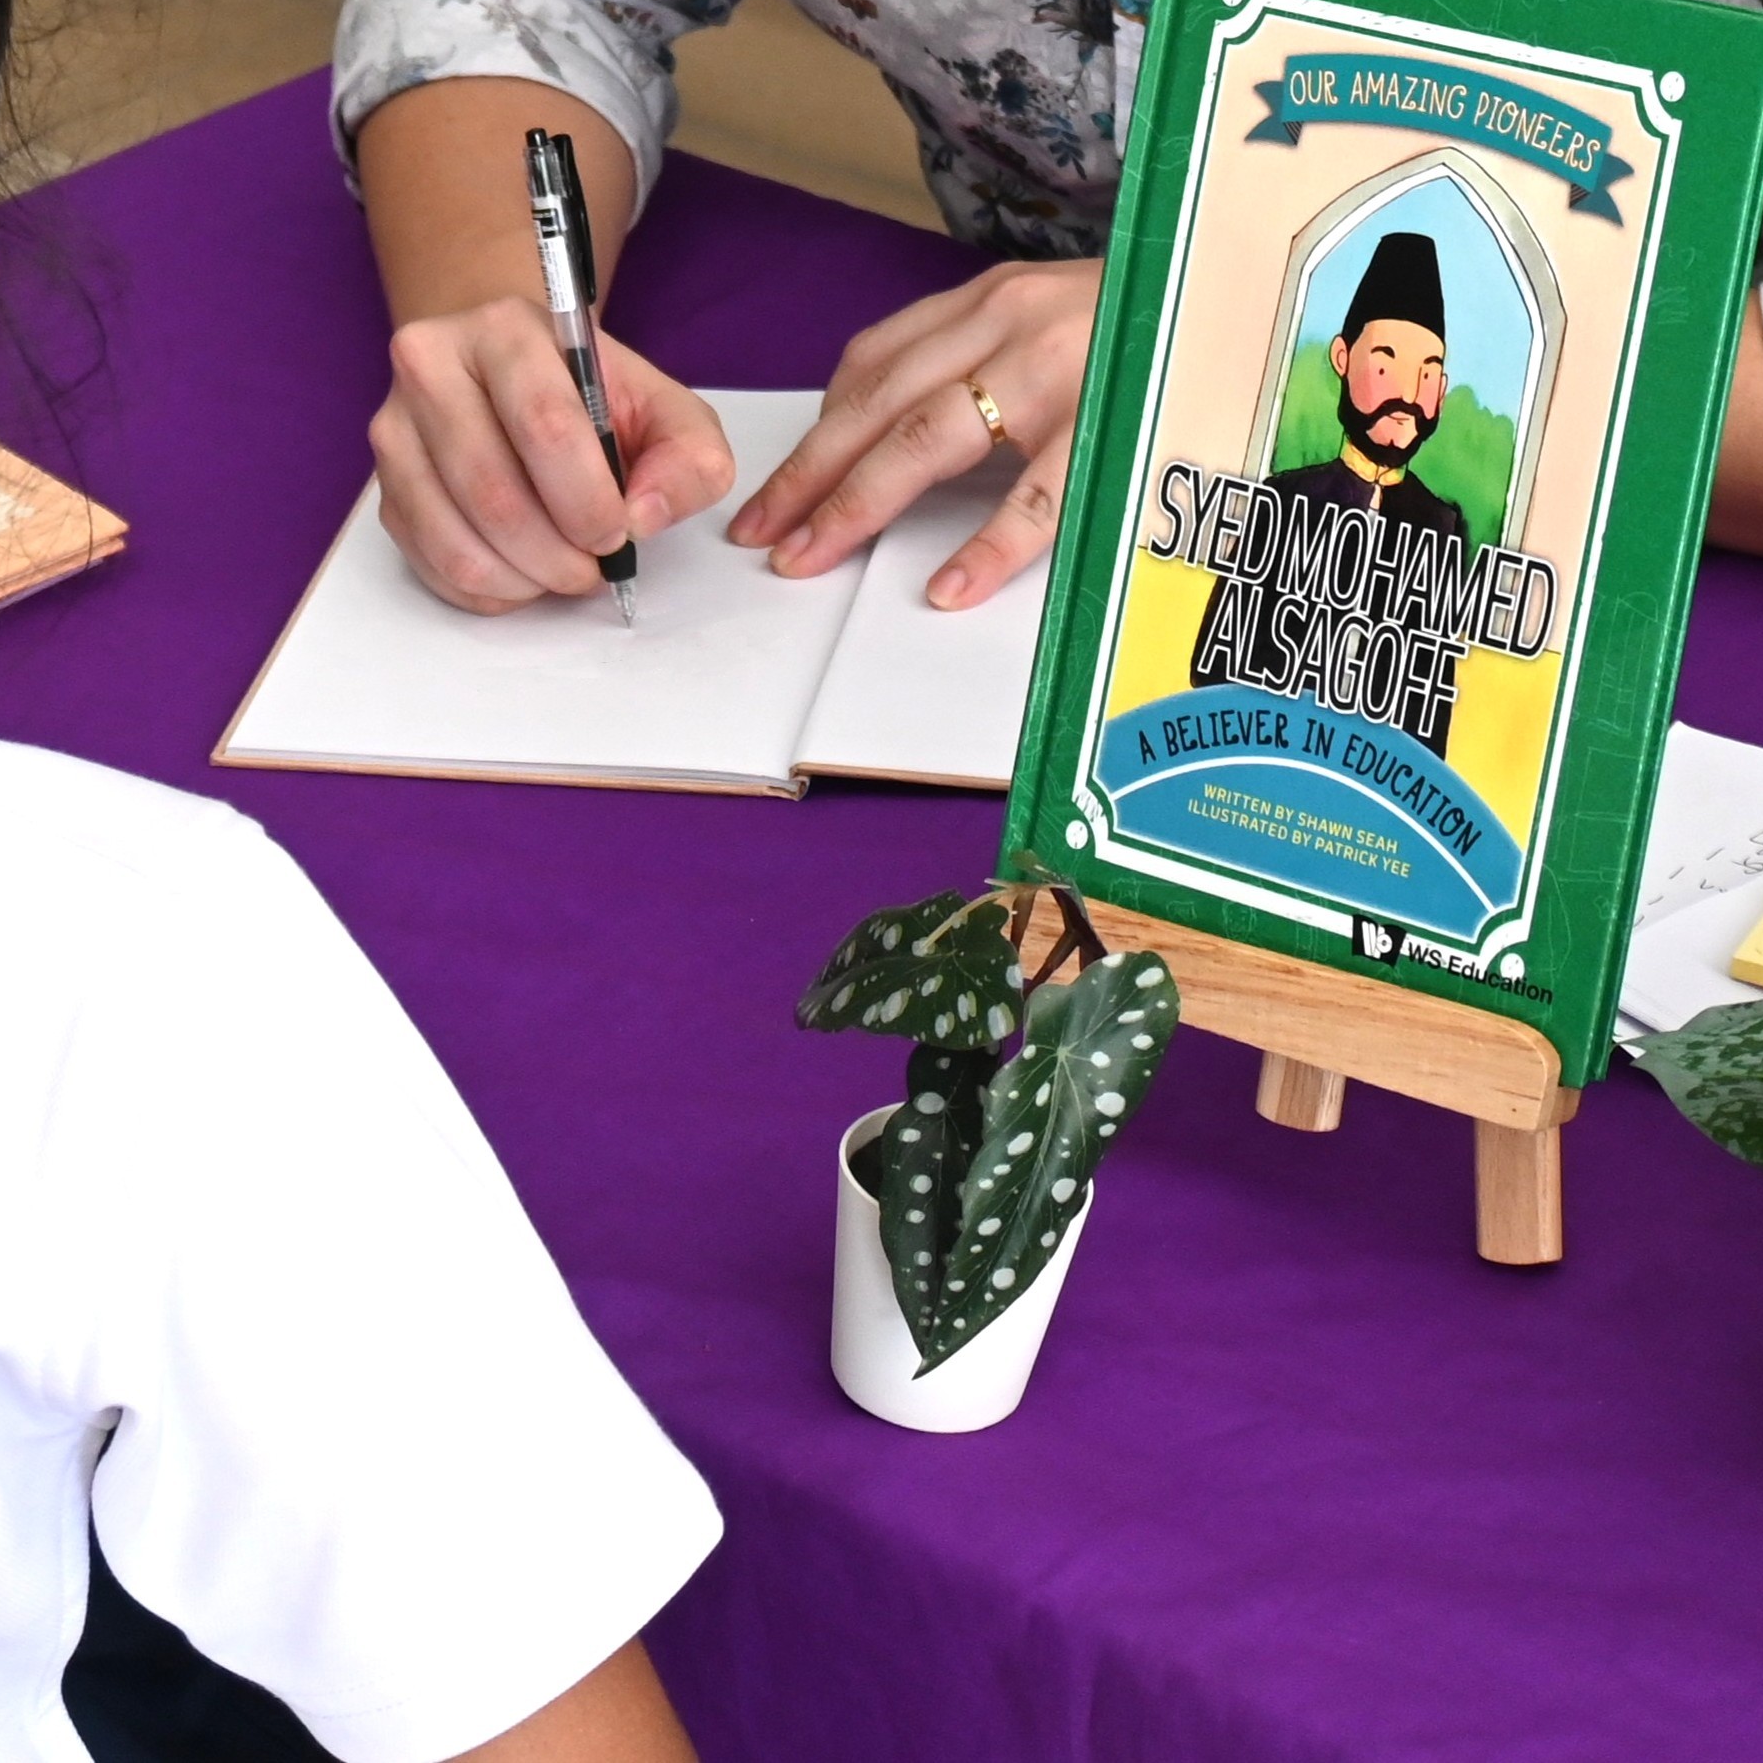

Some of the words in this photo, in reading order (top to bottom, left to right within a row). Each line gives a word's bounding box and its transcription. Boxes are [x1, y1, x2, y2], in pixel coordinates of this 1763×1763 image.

[1289, 70, 1338, 105] OUR
[1349, 74, 1467, 120] AMAZING
[1473, 92, 1601, 173] PIONEERS
[1148, 461, 1282, 585] SYED
[1276, 495, 1559, 661] MOHAMED
[1198, 579, 1468, 737] ALSAGOFF
[1138, 730, 1156, 765] A
[1162, 710, 1290, 757] BELIEVER
[1302, 718, 1336, 759] IN
[1342, 734, 1482, 857] EDUCATION
[1204, 784, 1272, 816] WRITTEN
[1274, 805, 1294, 822] BY
[1297, 812, 1354, 841] SHAWN
[1356, 829, 1398, 854] SEAH
[1188, 798, 1288, 840] ILLUSTRATED
[1292, 830, 1312, 848] BY
[1314, 837, 1379, 868] PATRICK
[1383, 857, 1411, 878] YEE
[1407, 942, 1442, 969] WS
[1447, 955, 1554, 1005] Education
